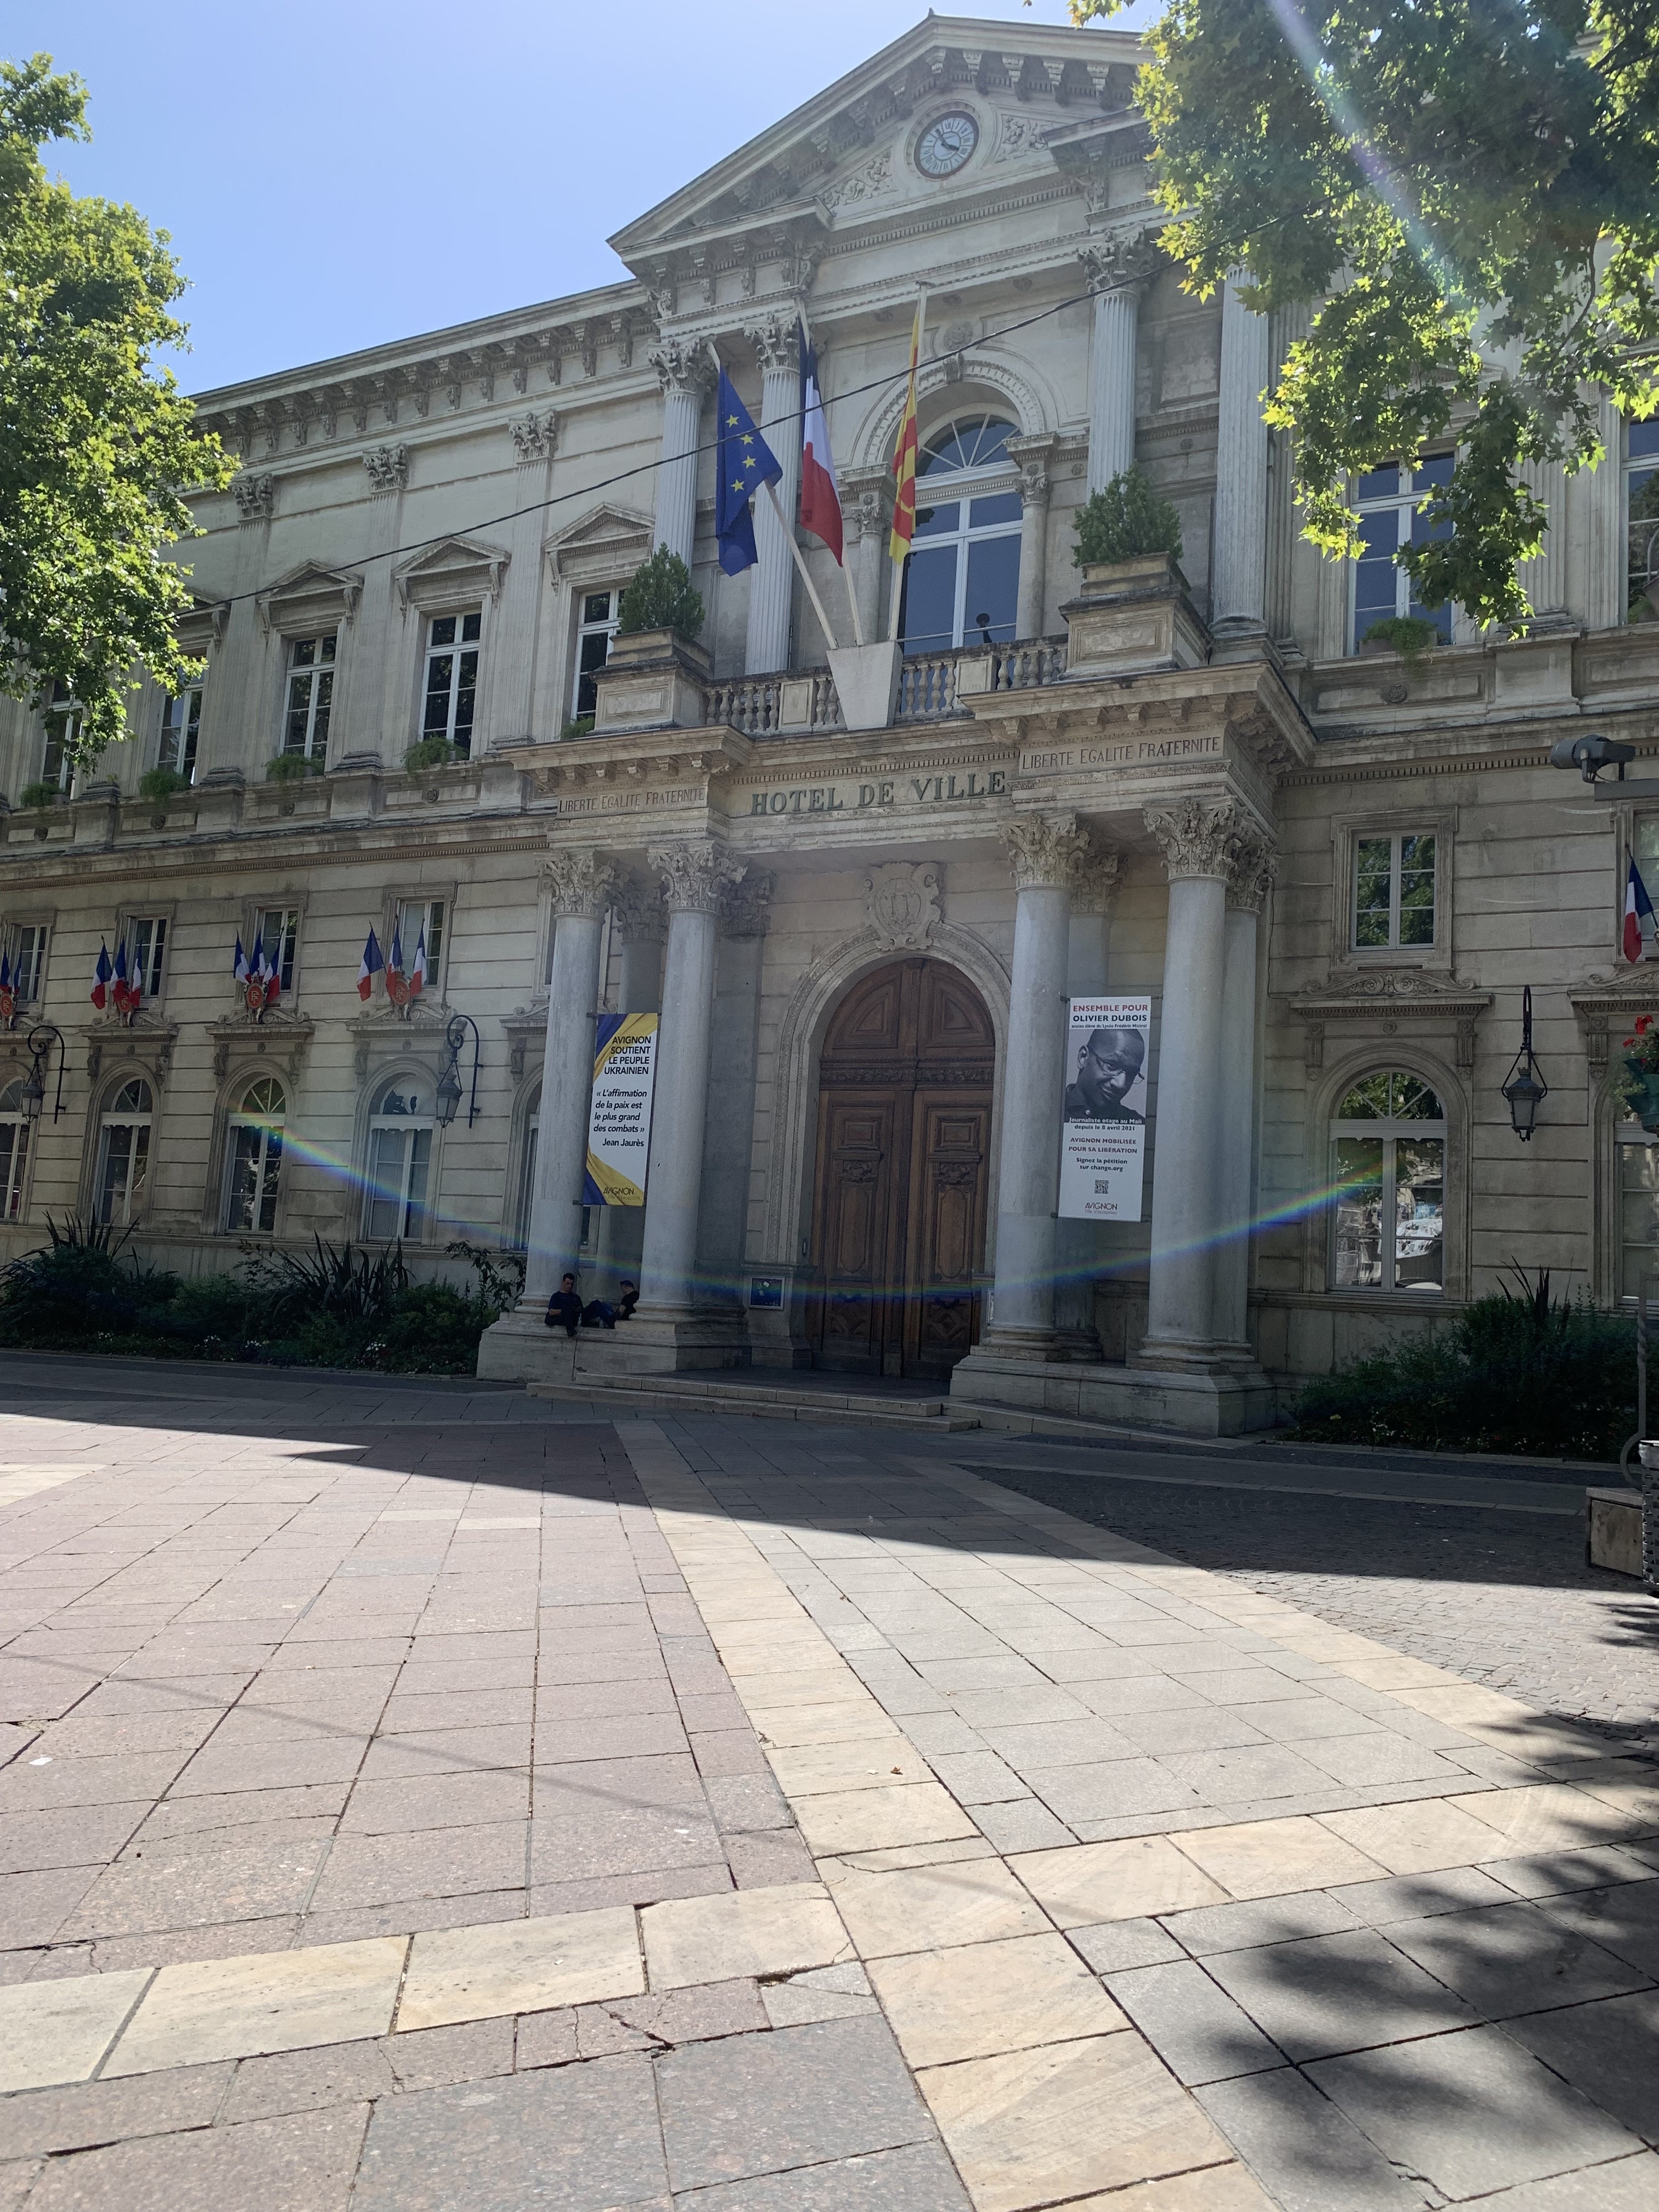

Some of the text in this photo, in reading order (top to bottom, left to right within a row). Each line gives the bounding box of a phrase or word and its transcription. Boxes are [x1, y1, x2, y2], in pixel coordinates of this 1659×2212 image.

[1022, 736, 1221, 769] LIBERTE EGALITE FRATERNITE
[751, 770, 1005, 815] HOTEL DE VILLE
[559, 788, 705, 813] LIBERTE EGALITE FRATERNITE
[612, 1036, 651, 1044] AVIGNON
[604, 1066, 648, 1075] UKRAINIEN
[613, 1101, 629, 1110] paix
[602, 1112, 617, 1122] plus
[618, 1112, 640, 1122] grand
[594, 1124, 606, 1132] des
[608, 1124, 639, 1132] combats
[602, 1138, 644, 1147] Jean Jaurès
[603, 1187, 634, 1195] AVIGNON
[1085, 1202, 1118, 1210] AVIGNON
